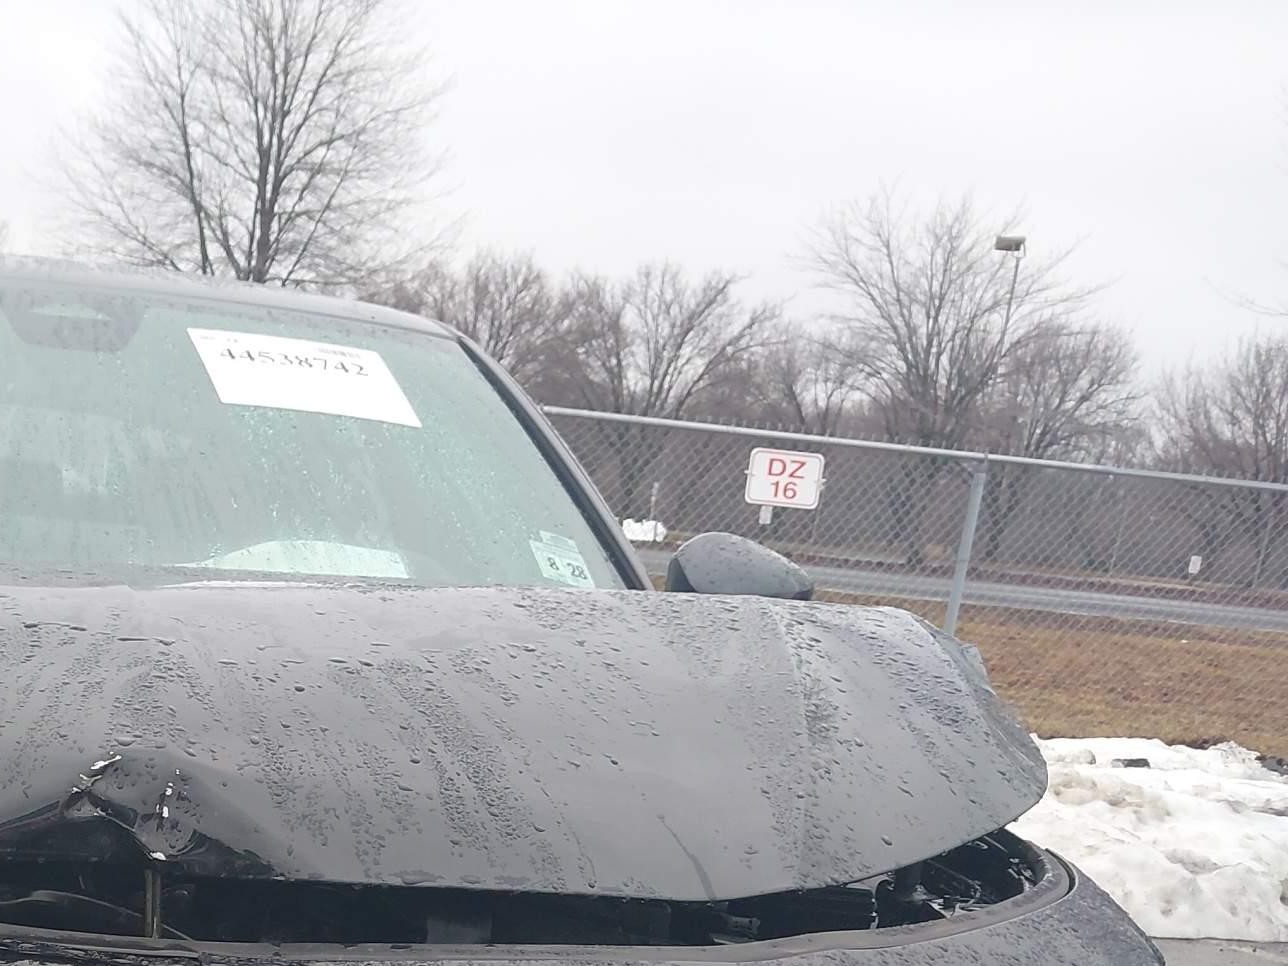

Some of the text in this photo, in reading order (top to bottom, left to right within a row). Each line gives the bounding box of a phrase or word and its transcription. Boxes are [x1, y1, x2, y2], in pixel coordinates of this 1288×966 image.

[219, 347, 369, 377] 44538742
[767, 457, 808, 480] DZ
[770, 480, 798, 499] 16
[547, 556, 588, 580] 8 28
